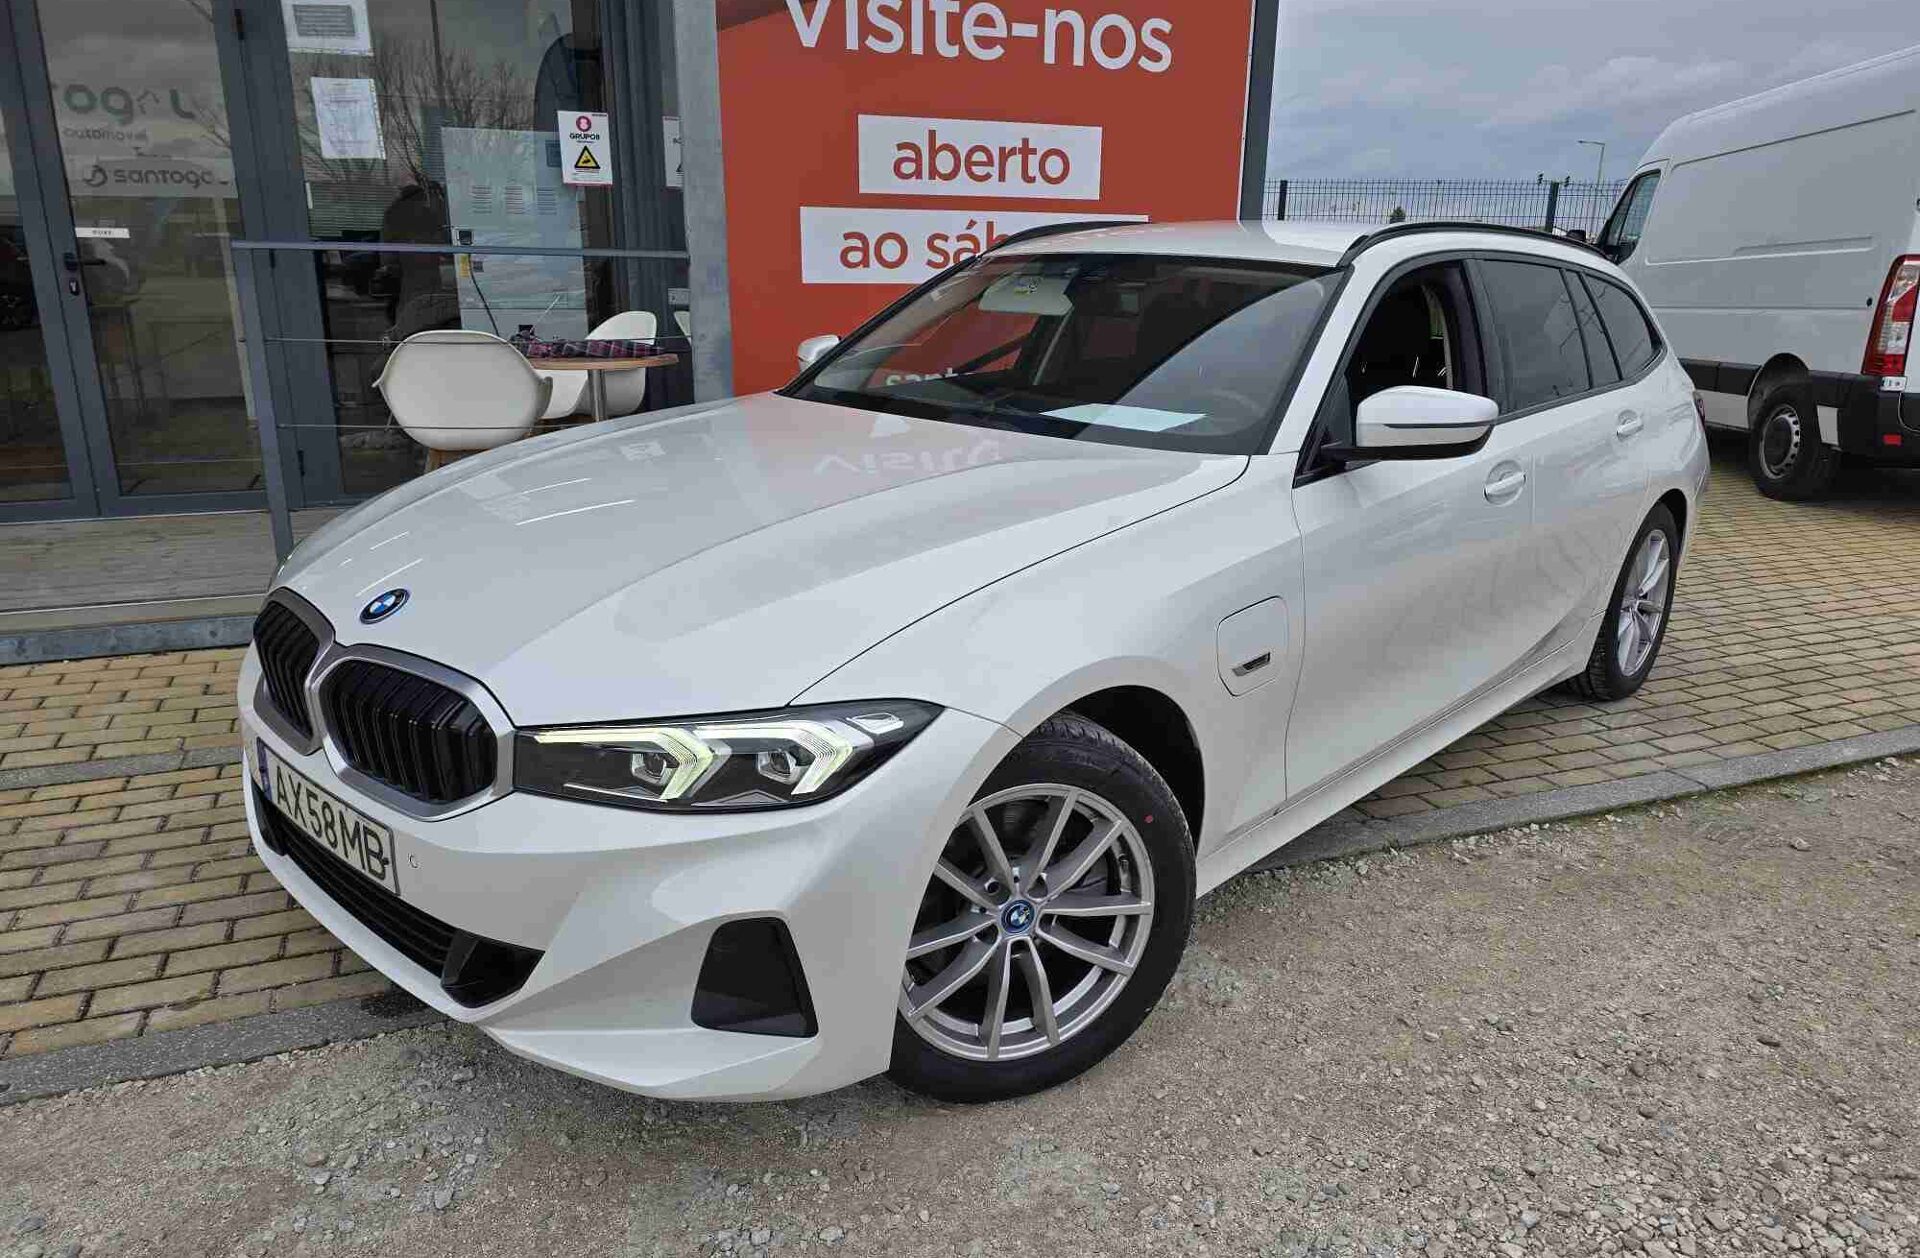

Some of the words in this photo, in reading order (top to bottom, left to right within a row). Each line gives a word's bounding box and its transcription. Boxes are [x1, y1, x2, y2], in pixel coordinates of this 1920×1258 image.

[786, 0, 1173, 73] Visite-nos
[892, 129, 1071, 186] aberto
[839, 229, 908, 270] ao
[276, 765, 387, 881] AX58MB
